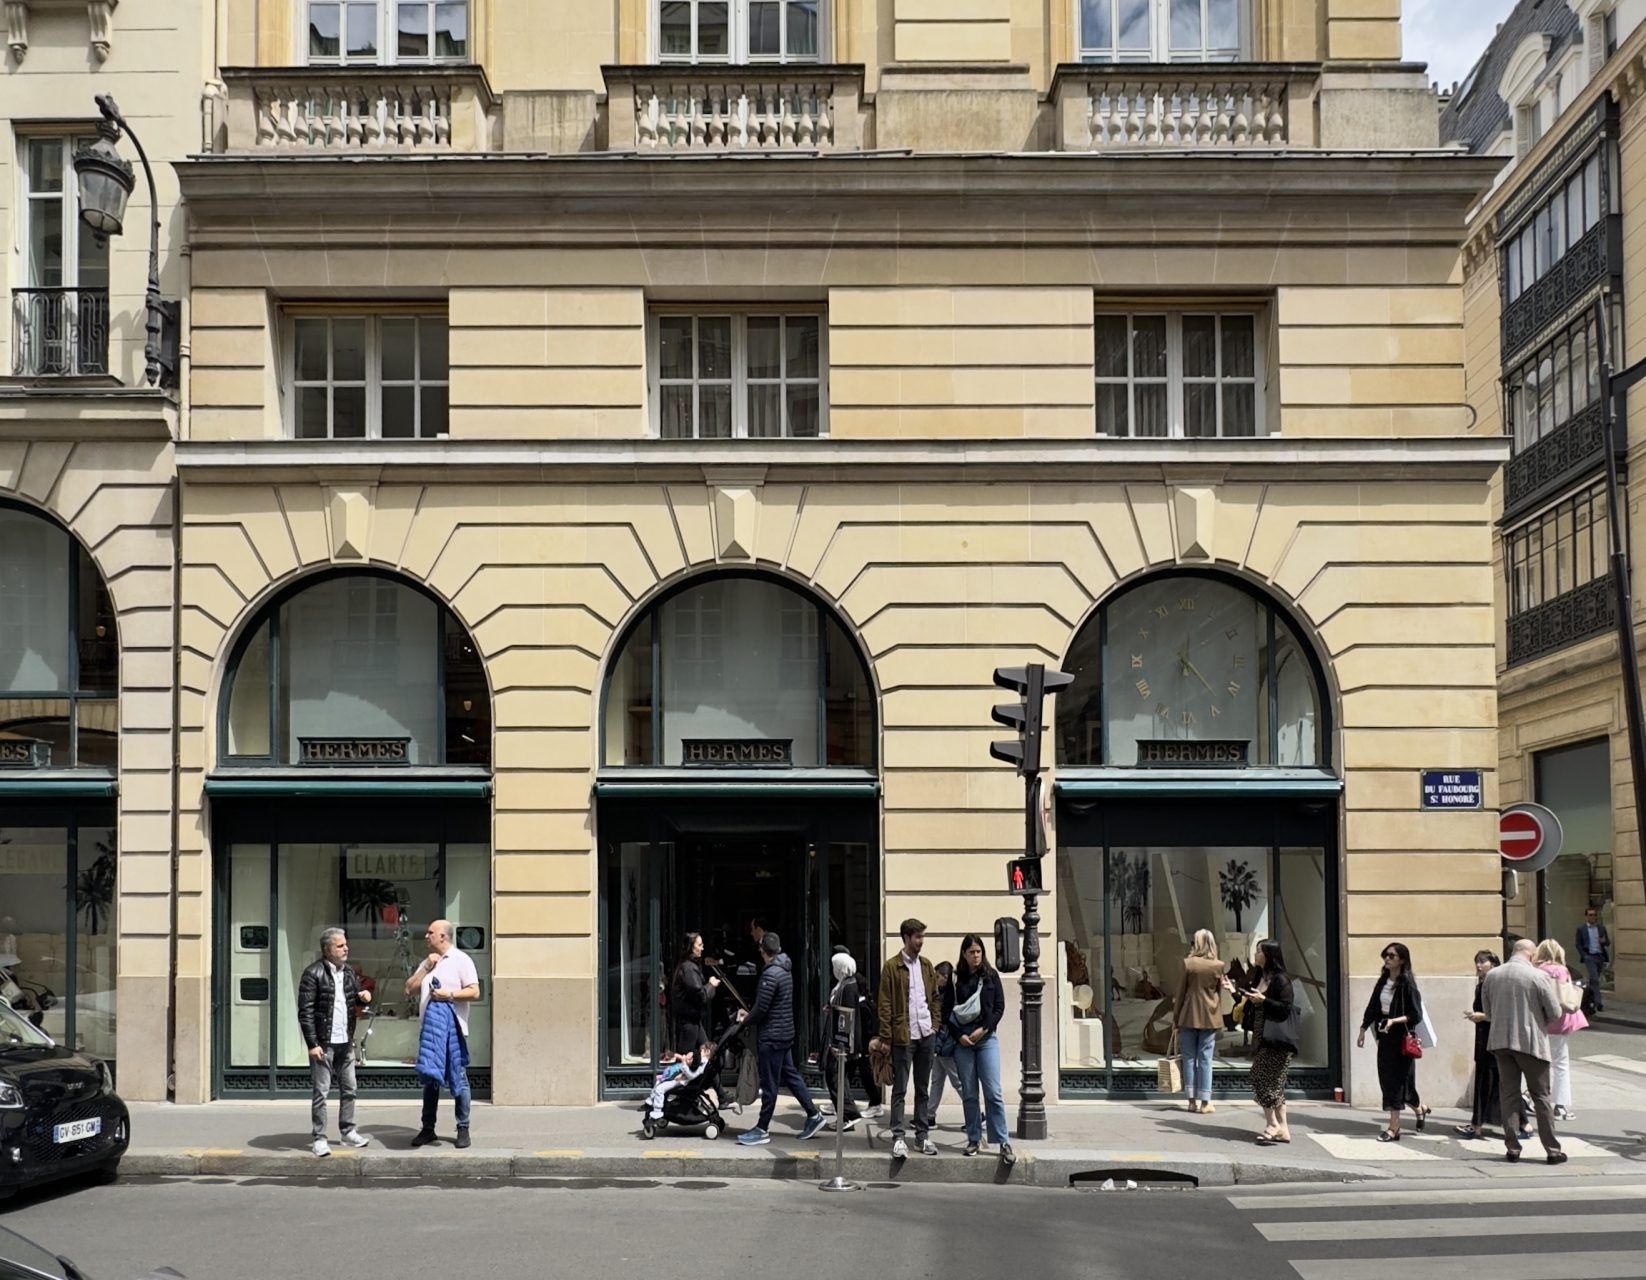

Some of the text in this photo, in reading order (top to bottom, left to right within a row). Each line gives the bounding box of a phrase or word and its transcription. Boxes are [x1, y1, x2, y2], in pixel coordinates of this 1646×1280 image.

[1443, 775, 1460, 784] RUE
[1425, 785, 1479, 794] DU FAUBOURG
[1441, 793, 1475, 804] HONORÉ
